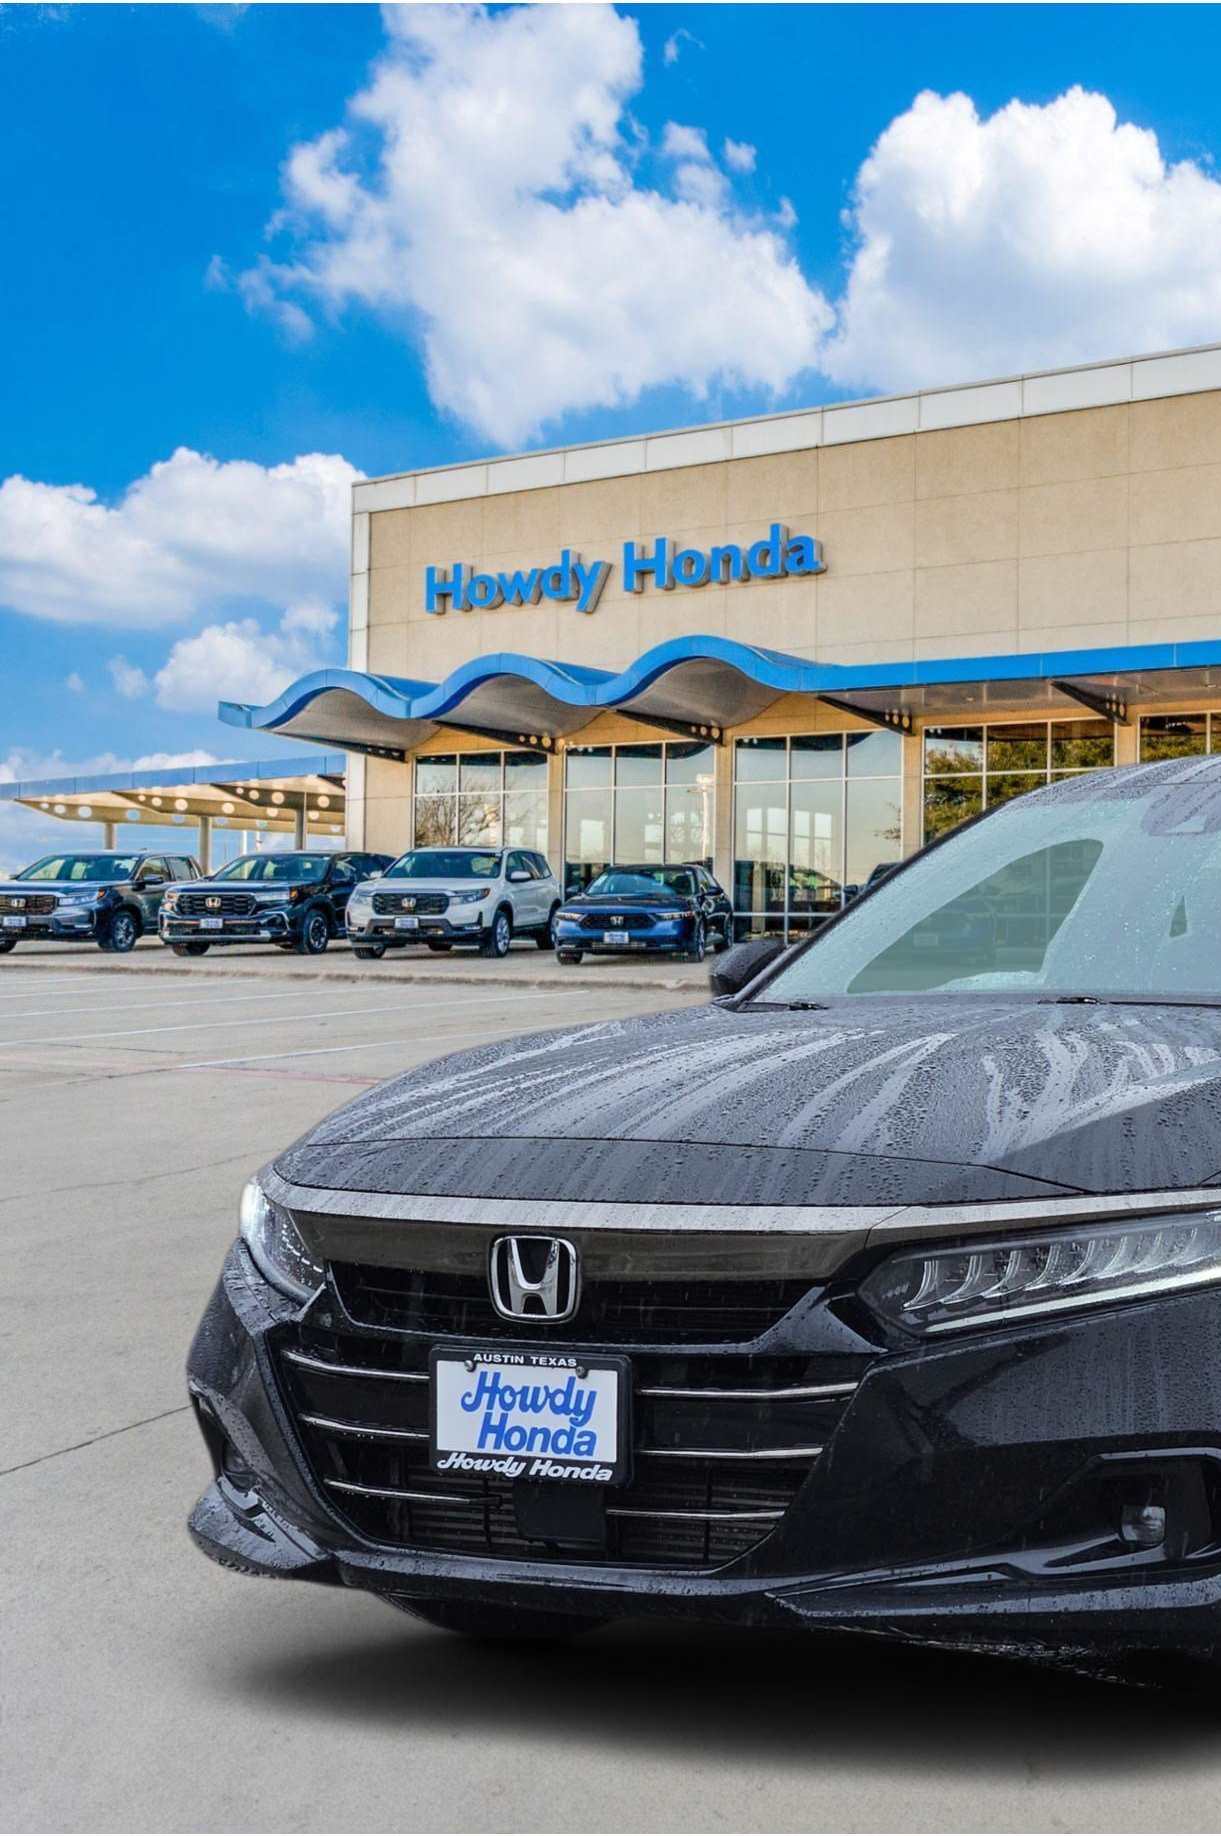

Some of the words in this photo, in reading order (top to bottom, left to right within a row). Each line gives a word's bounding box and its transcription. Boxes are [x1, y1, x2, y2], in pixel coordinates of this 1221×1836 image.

[425, 547, 612, 616] Howdy
[622, 523, 827, 594] Honda
[473, 1353, 524, 1365] AUSTIN
[530, 1356, 577, 1367] TEXAS
[461, 1371, 597, 1427] Howdy
[477, 1412, 597, 1456] Honda
[437, 1452, 527, 1478] Howdy
[529, 1459, 613, 1481] Honda
